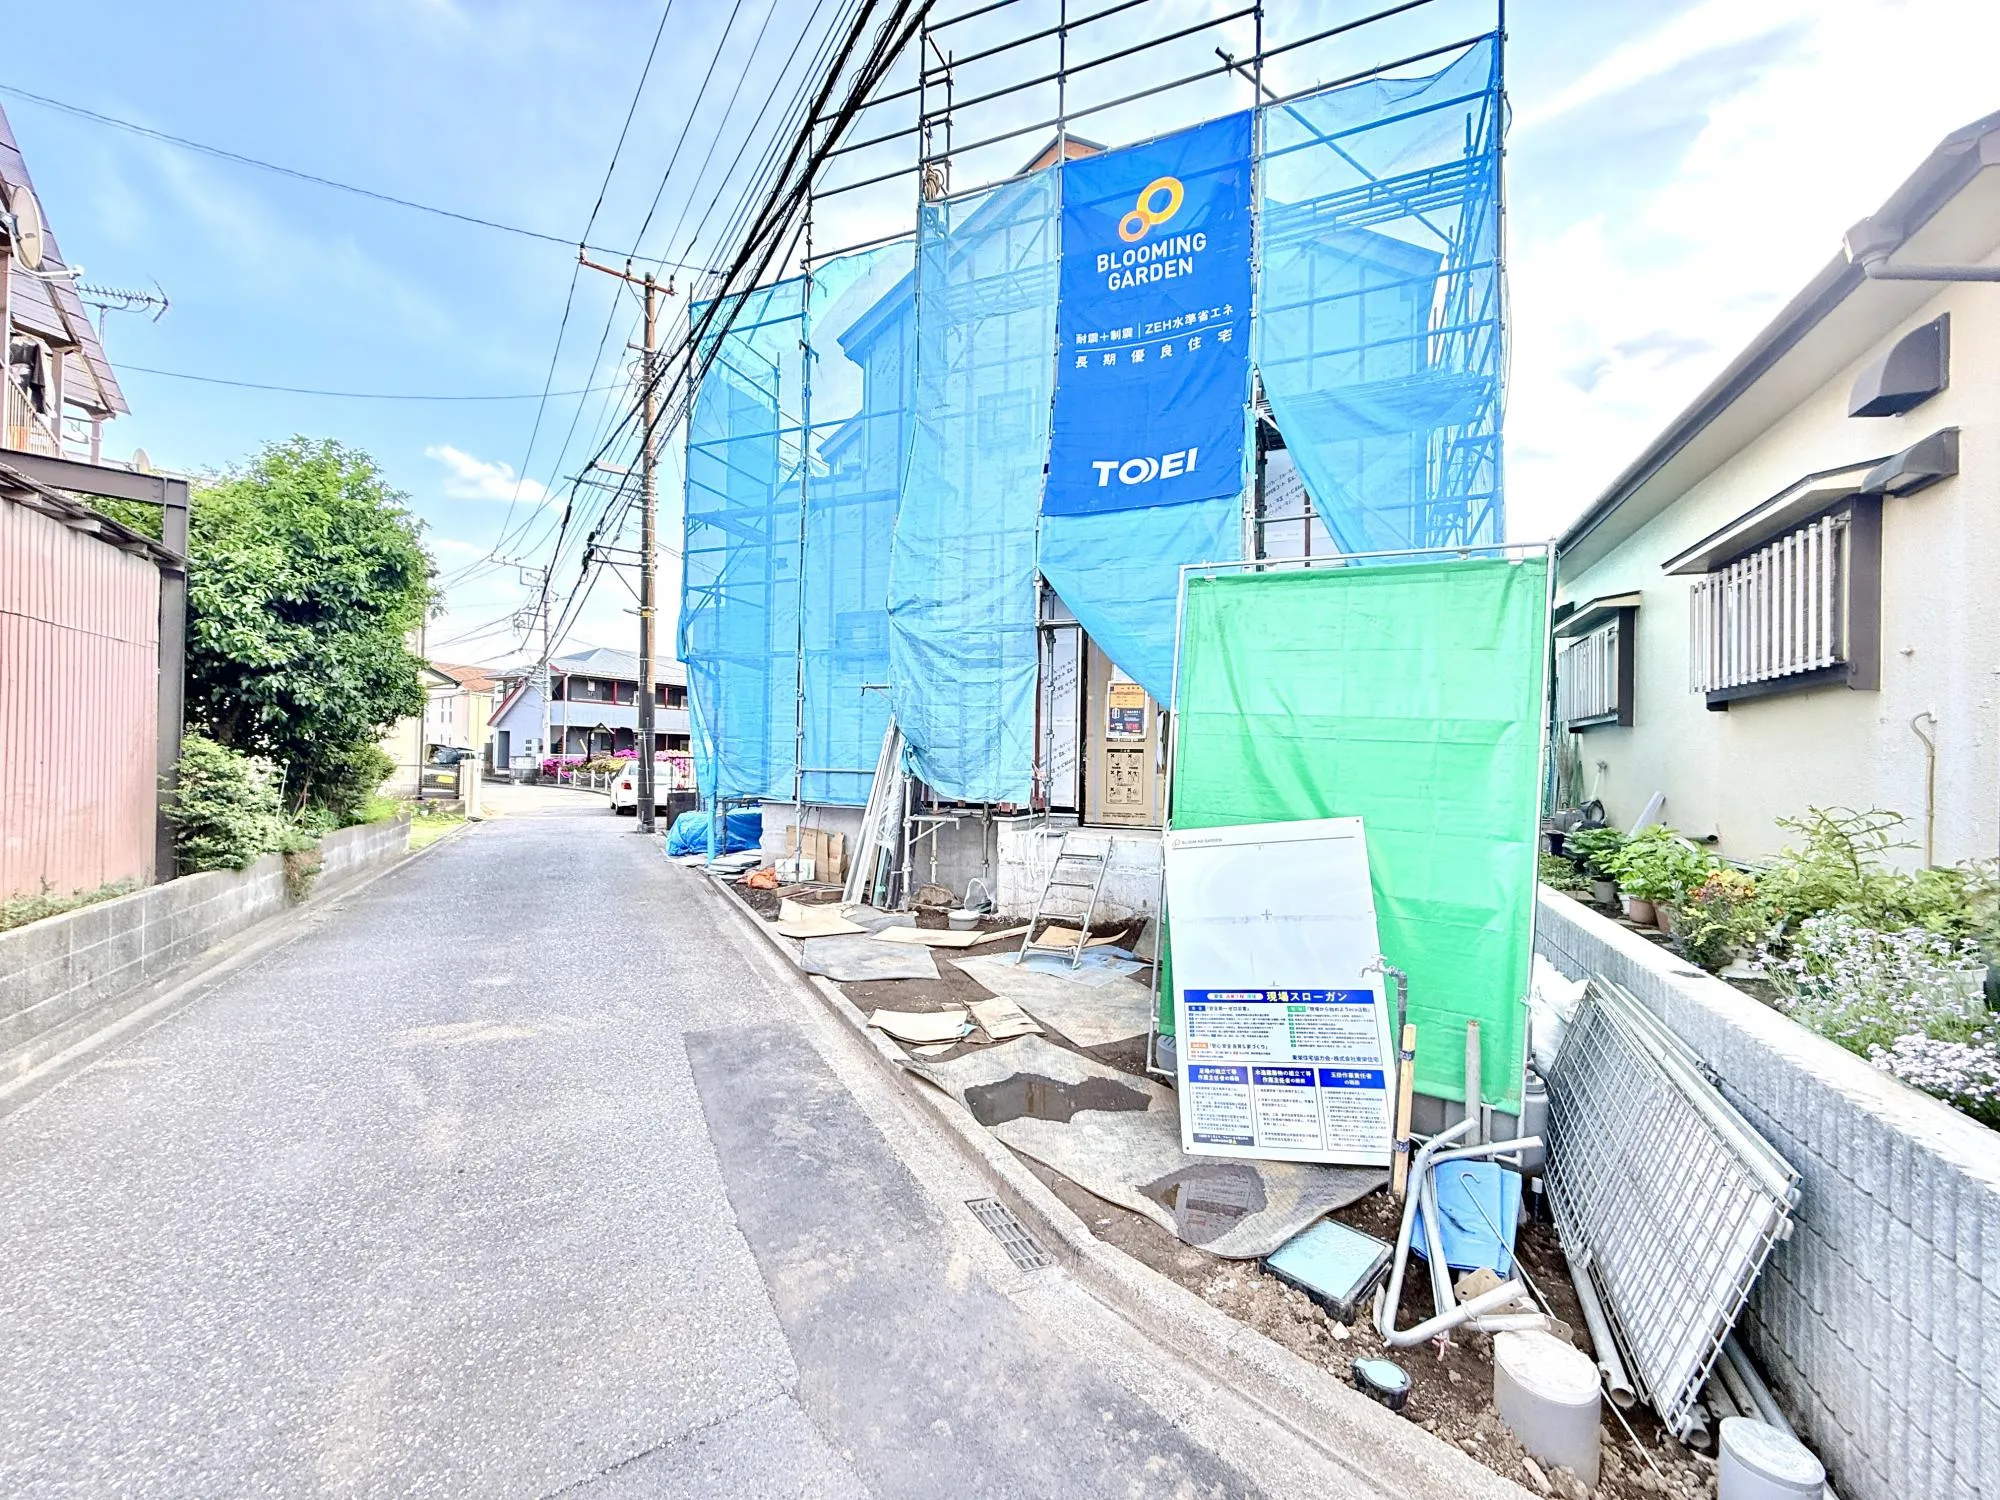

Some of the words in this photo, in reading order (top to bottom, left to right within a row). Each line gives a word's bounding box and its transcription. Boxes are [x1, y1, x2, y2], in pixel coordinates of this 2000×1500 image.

[1097, 233, 1207, 273] BLOOMING
[1108, 257, 1193, 291] GARDEN
[1266, 991, 1348, 1003] 現場スローガン
